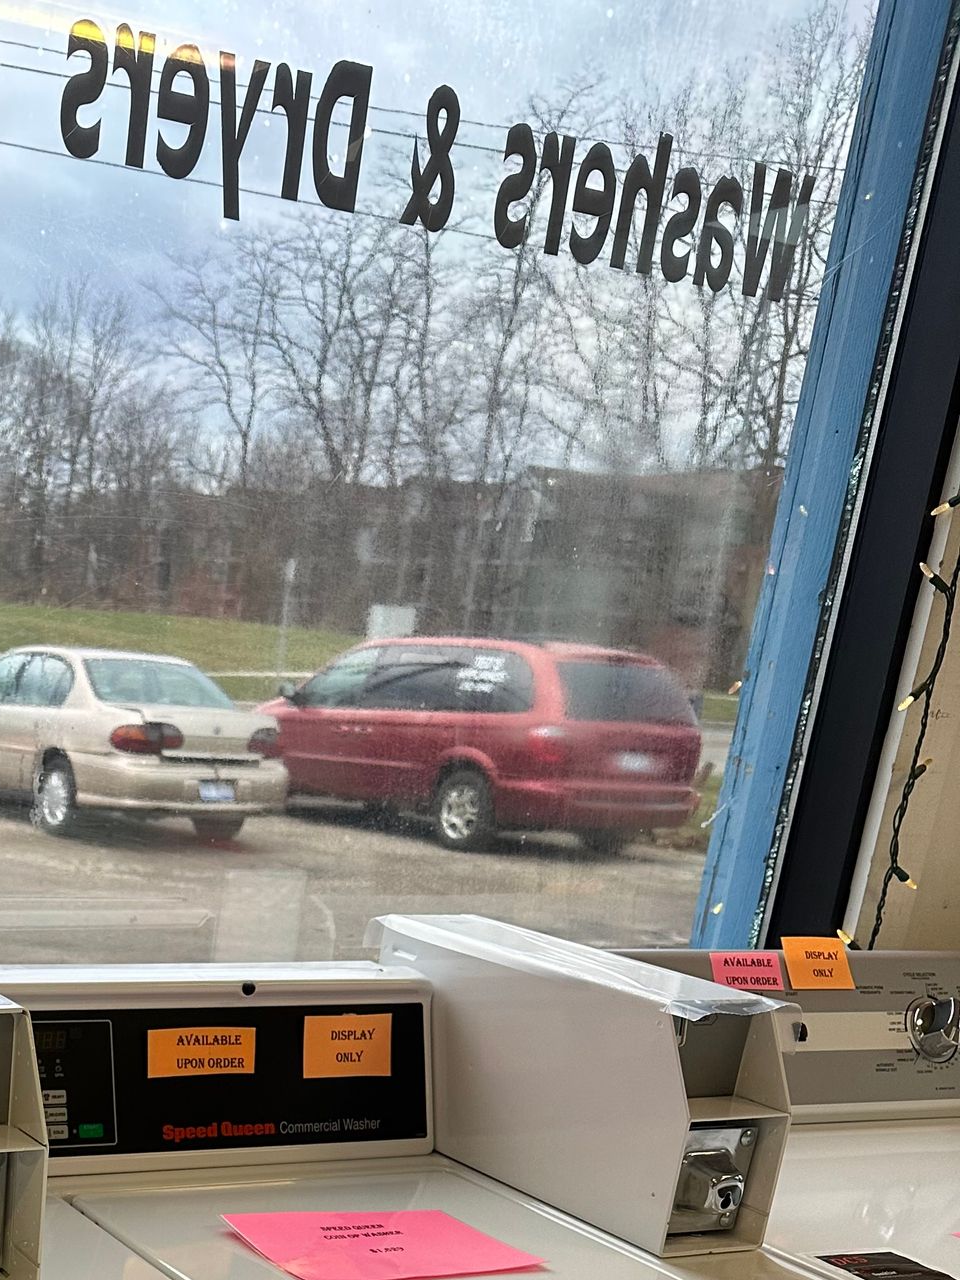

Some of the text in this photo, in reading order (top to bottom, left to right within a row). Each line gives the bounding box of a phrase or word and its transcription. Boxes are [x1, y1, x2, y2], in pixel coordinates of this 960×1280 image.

[805, 950, 838, 961] DISPLAY
[723, 957, 773, 968] AVAILABLE
[813, 968, 834, 978] ONLY
[726, 976, 779, 986] UPON ORDER
[176, 1034, 242, 1046] AVAILABLE
[330, 1028, 376, 1041] DISPLAY
[335, 1050, 363, 1063] ONLY
[176, 1057, 245, 1069] UPON ORDER
[162, 1117, 381, 1143] Speed Queen Commercial Washer
